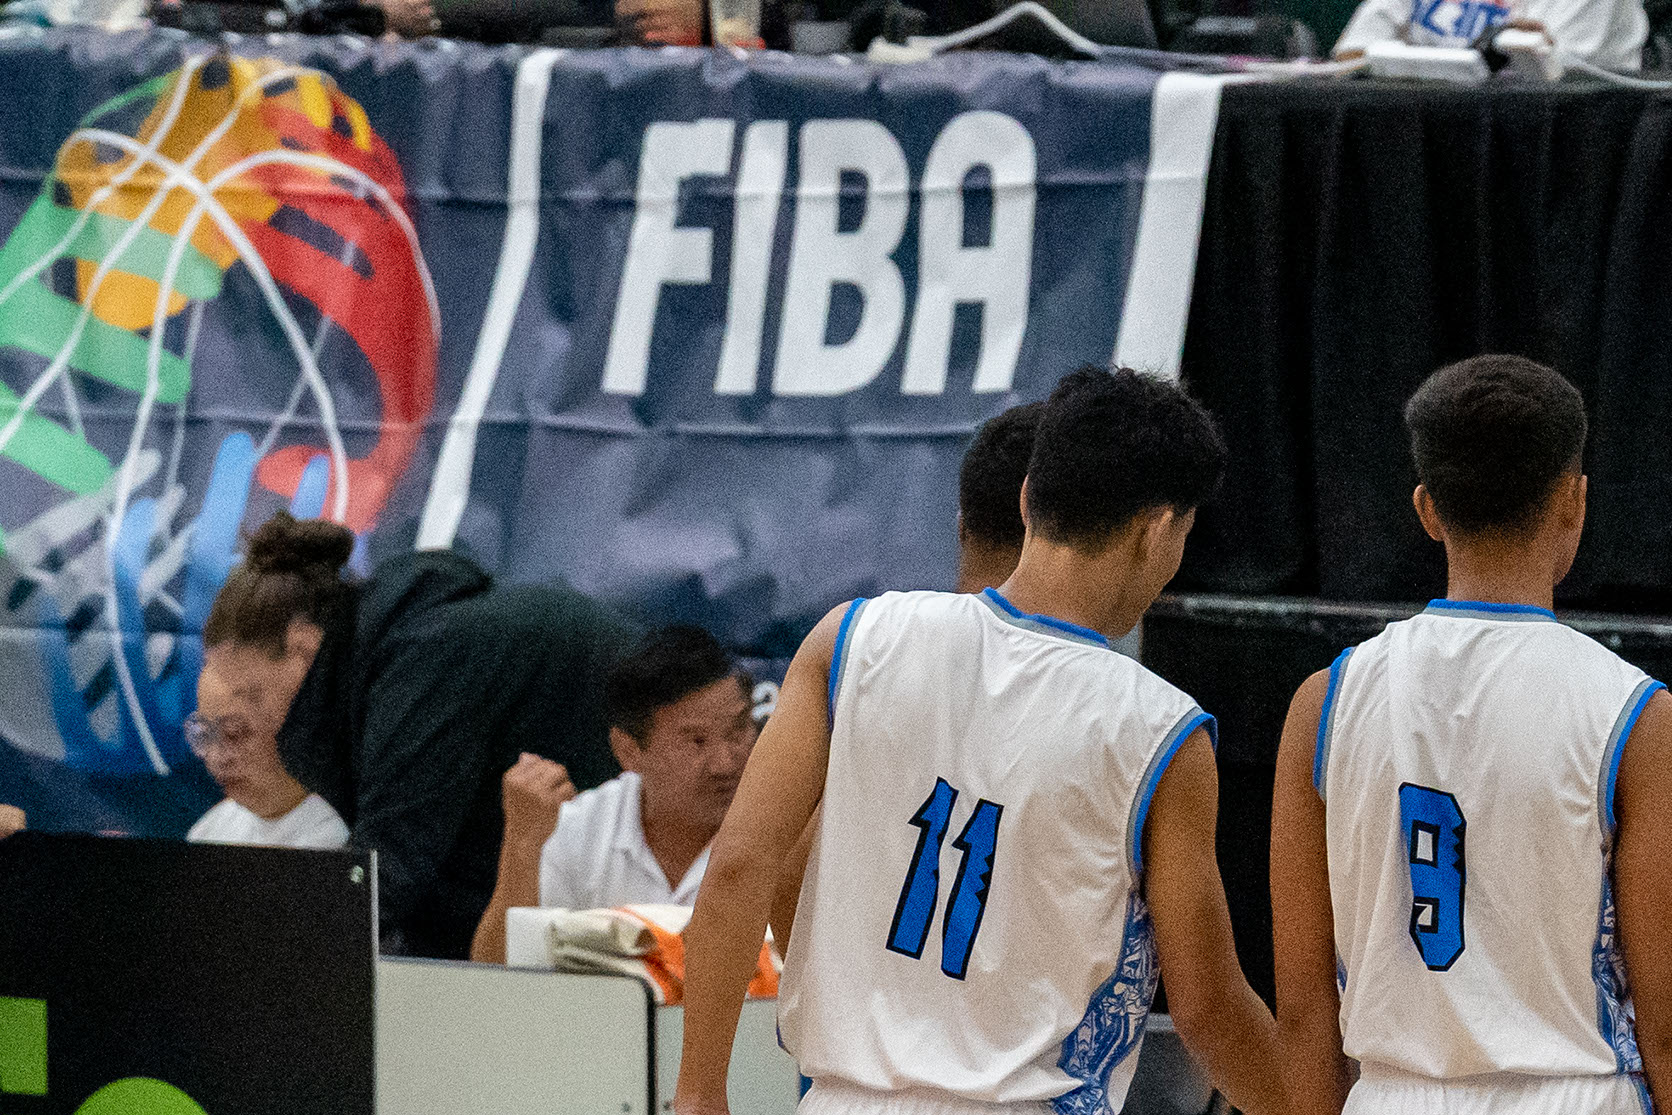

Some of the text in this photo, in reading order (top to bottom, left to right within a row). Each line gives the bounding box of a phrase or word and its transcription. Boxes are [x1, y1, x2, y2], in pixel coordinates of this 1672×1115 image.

[602, 110, 1037, 396] FIBA
[885, 777, 1004, 981] 11
[1398, 781, 1467, 971] 9
